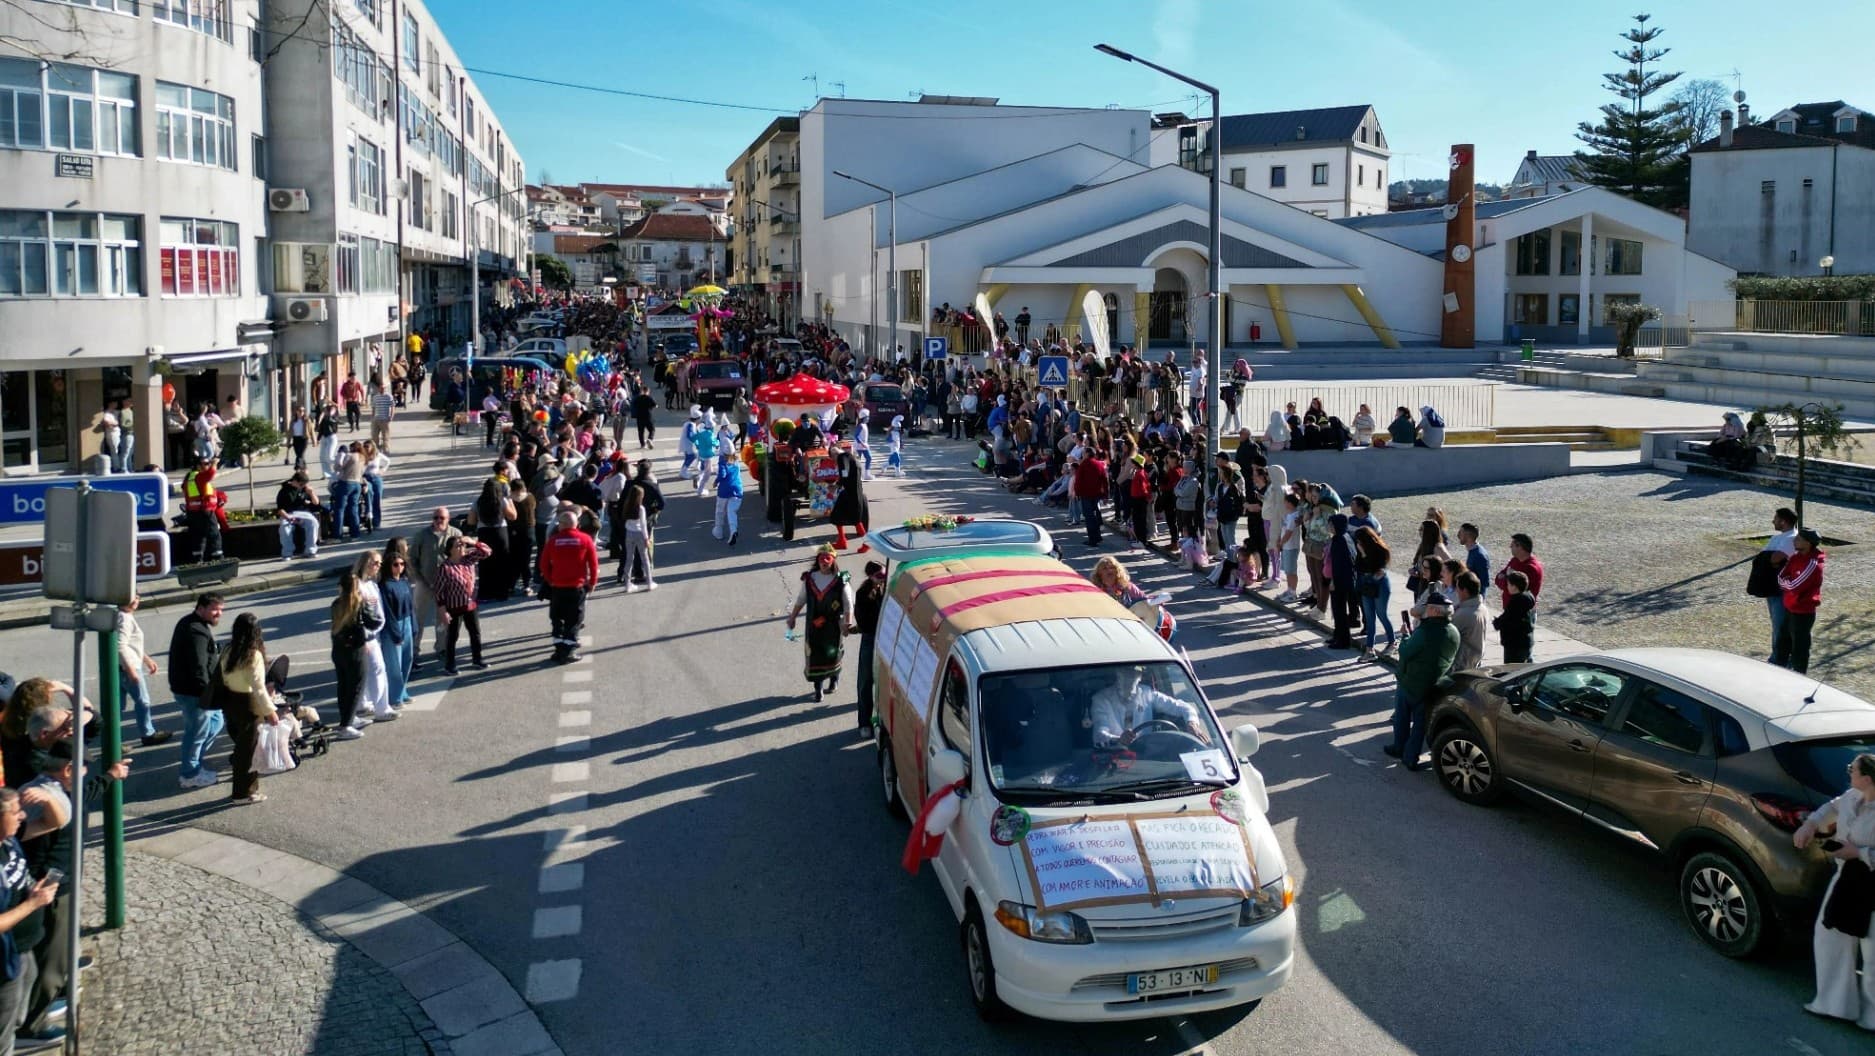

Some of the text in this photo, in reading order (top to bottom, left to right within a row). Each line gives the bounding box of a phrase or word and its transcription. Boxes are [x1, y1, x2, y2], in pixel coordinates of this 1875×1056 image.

[928, 339, 943, 358] P
[1201, 758, 1217, 777] 5
[1030, 848, 1047, 858] COM
[1053, 842, 1076, 853] VIGOR
[1041, 882, 1057, 895] COM
[1059, 880, 1083, 892] AMOR
